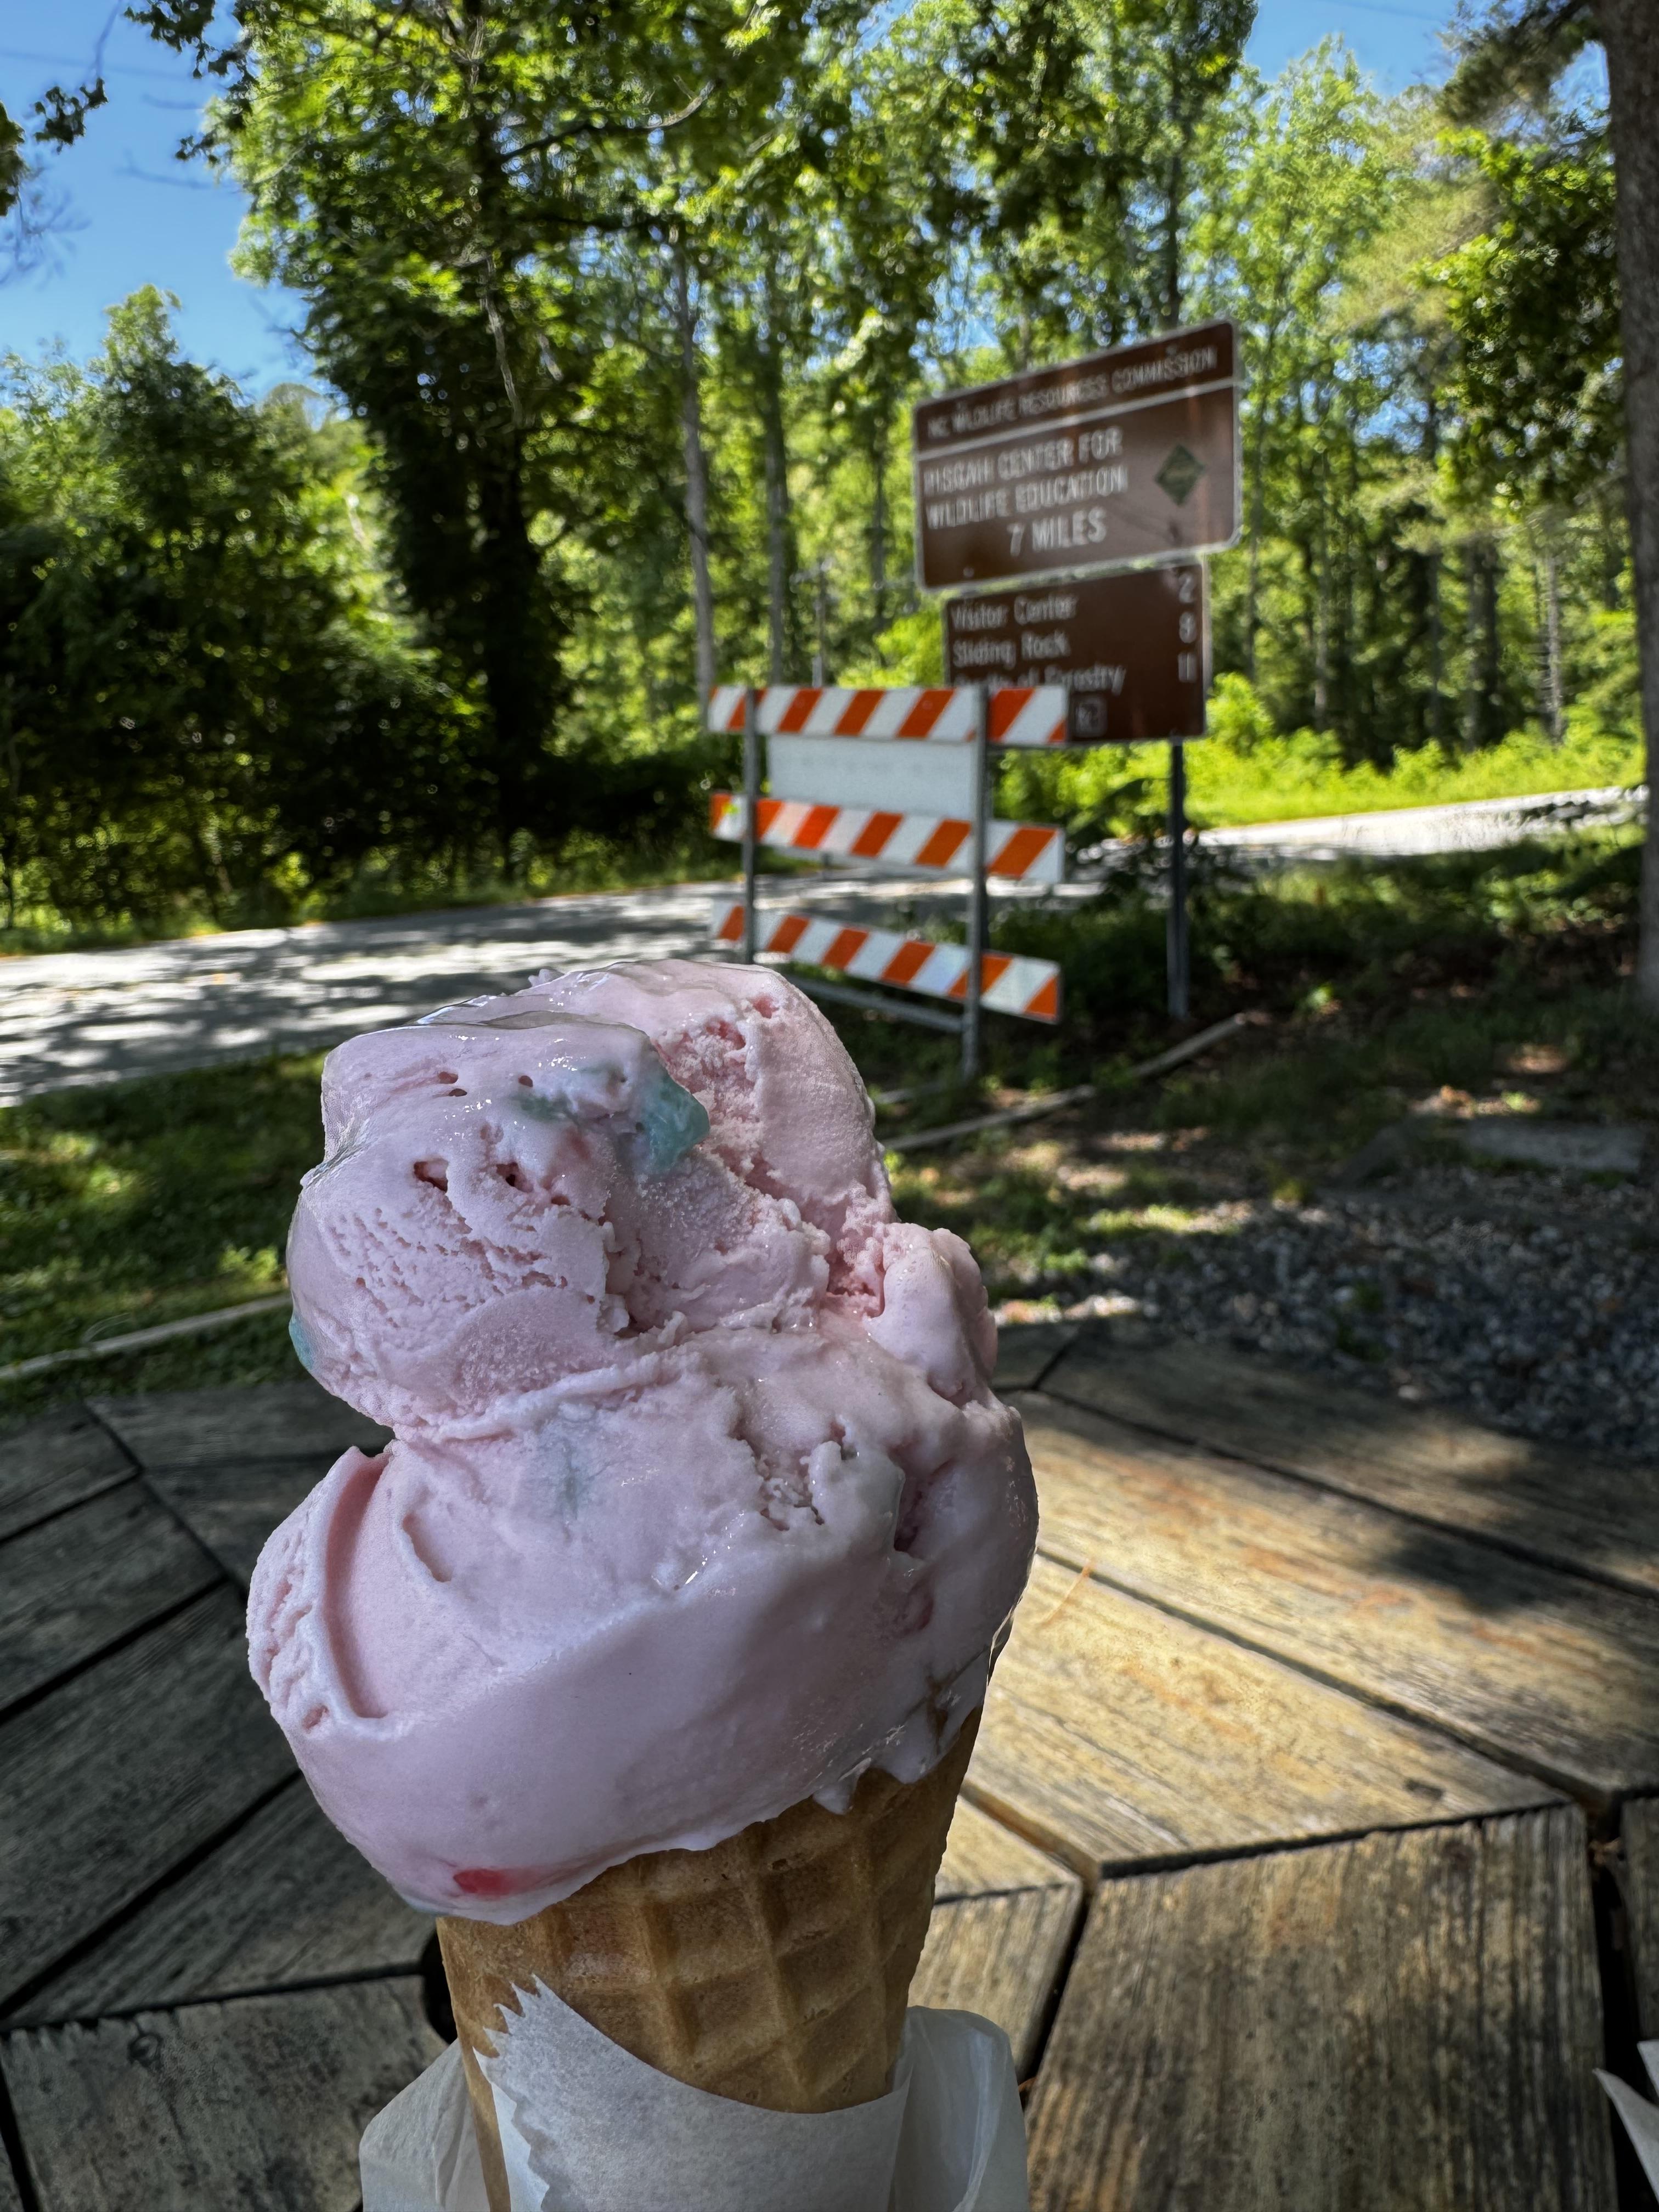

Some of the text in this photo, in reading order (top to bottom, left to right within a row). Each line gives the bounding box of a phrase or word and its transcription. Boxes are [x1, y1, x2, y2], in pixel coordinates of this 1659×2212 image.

[952, 398, 1017, 433] WILDLIFE
[1018, 373, 1110, 414] RESOURCES
[1111, 346, 1218, 393] COMMISSION
[924, 426, 1123, 495] PISGAH CENTER FOR
[927, 464, 1128, 529] WILDLIFE EDUCATION
[1007, 505, 1107, 557] 7 MILES
[951, 573, 1197, 631] Visitor Center 2
[953, 638, 1016, 670] Sliding
[1022, 628, 1071, 660] Rock
[1178, 652, 1197, 682] 11
